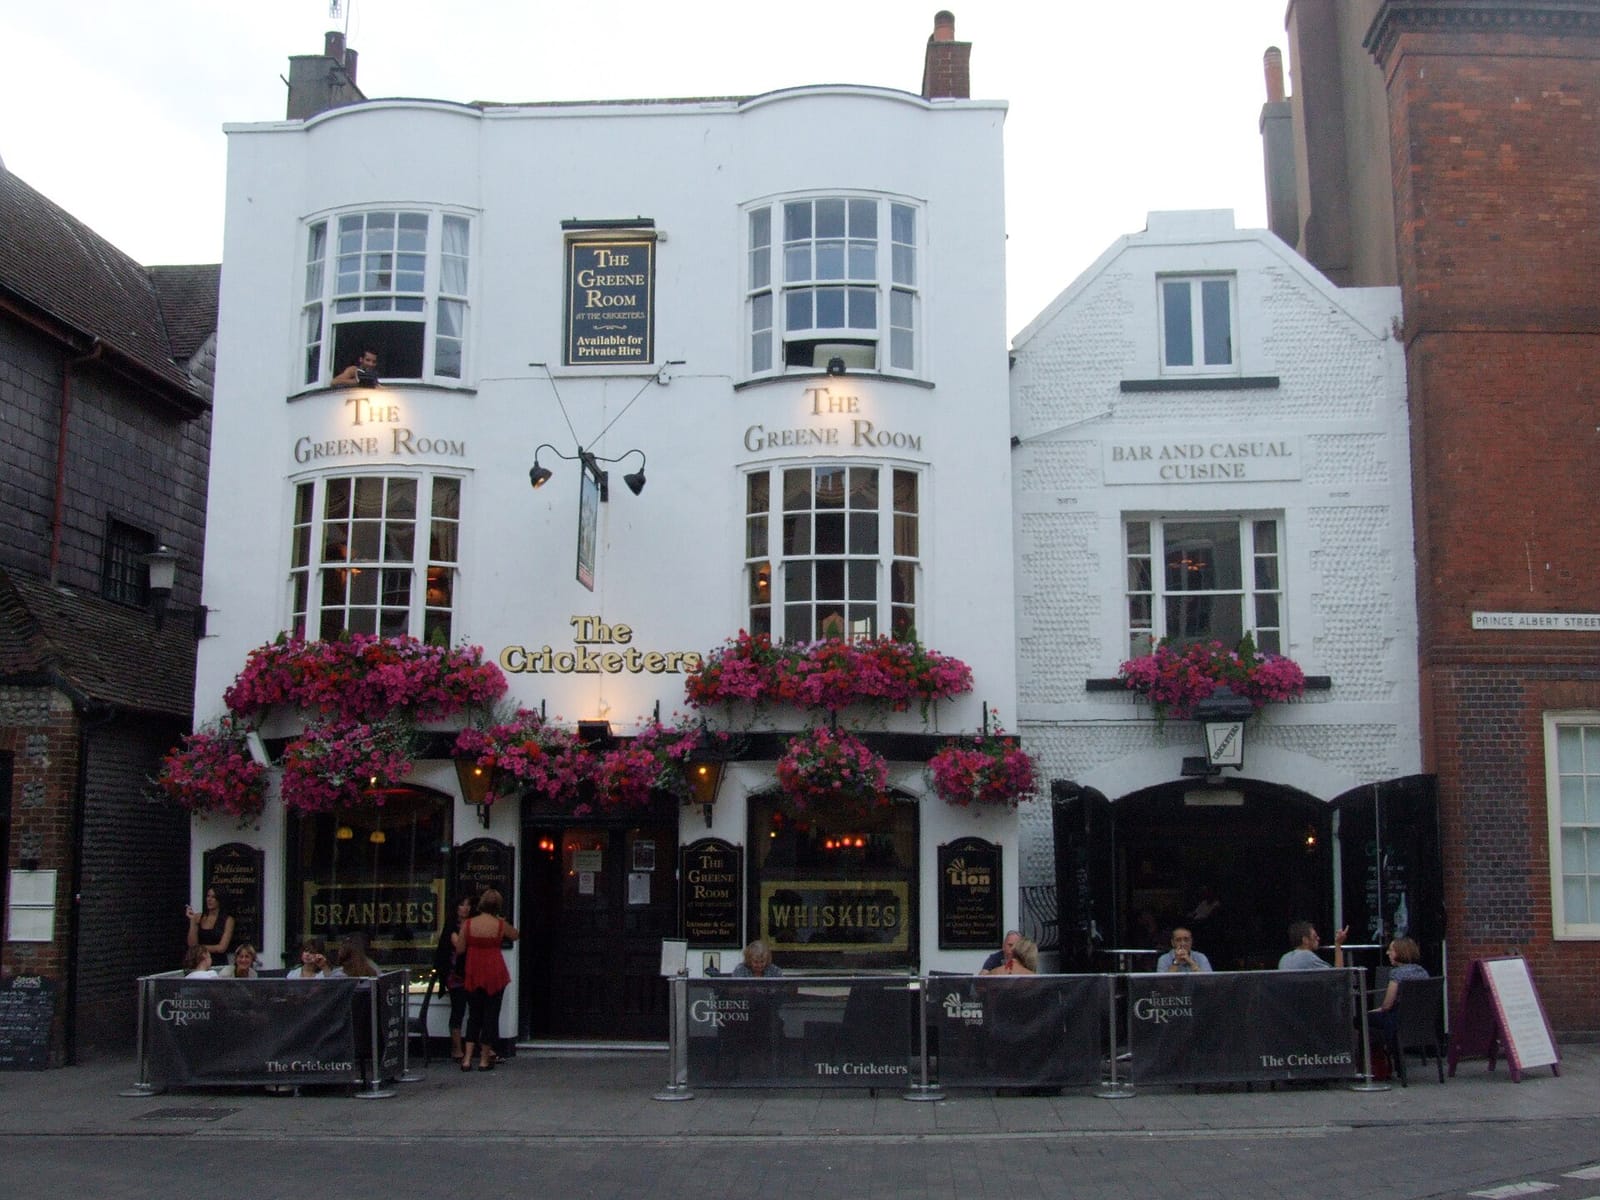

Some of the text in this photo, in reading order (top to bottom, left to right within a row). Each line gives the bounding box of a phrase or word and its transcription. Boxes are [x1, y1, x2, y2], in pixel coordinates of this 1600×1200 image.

[594, 250, 629, 267] THE
[577, 270, 645, 287] GREENE
[585, 290, 636, 308] ROOM
[577, 335, 643, 345] Available for
[578, 346, 641, 356] Private Hire
[805, 387, 861, 415] THE
[345, 398, 400, 426] THE
[744, 419, 922, 452] GREENE ROOM
[294, 428, 466, 464] GREENE ROOM
[1112, 442, 1292, 462] BAR AND CASUAL
[1160, 463, 1246, 480] CUISINE
[1476, 616, 1514, 626] PRINCE
[1518, 616, 1559, 626] ALBERT
[570, 615, 633, 645] The
[499, 645, 704, 674] Cricketers
[952, 871, 990, 885] Lion
[694, 886, 729, 898] ROOM
[313, 902, 434, 925] BRANDIES
[772, 904, 896, 927] WHISKIES
[947, 1005, 983, 1018] Lion
[265, 1060, 352, 1072] The Cricketers
[815, 1062, 908, 1074] The Cricketers
[1260, 1053, 1352, 1067] The Cricketers
